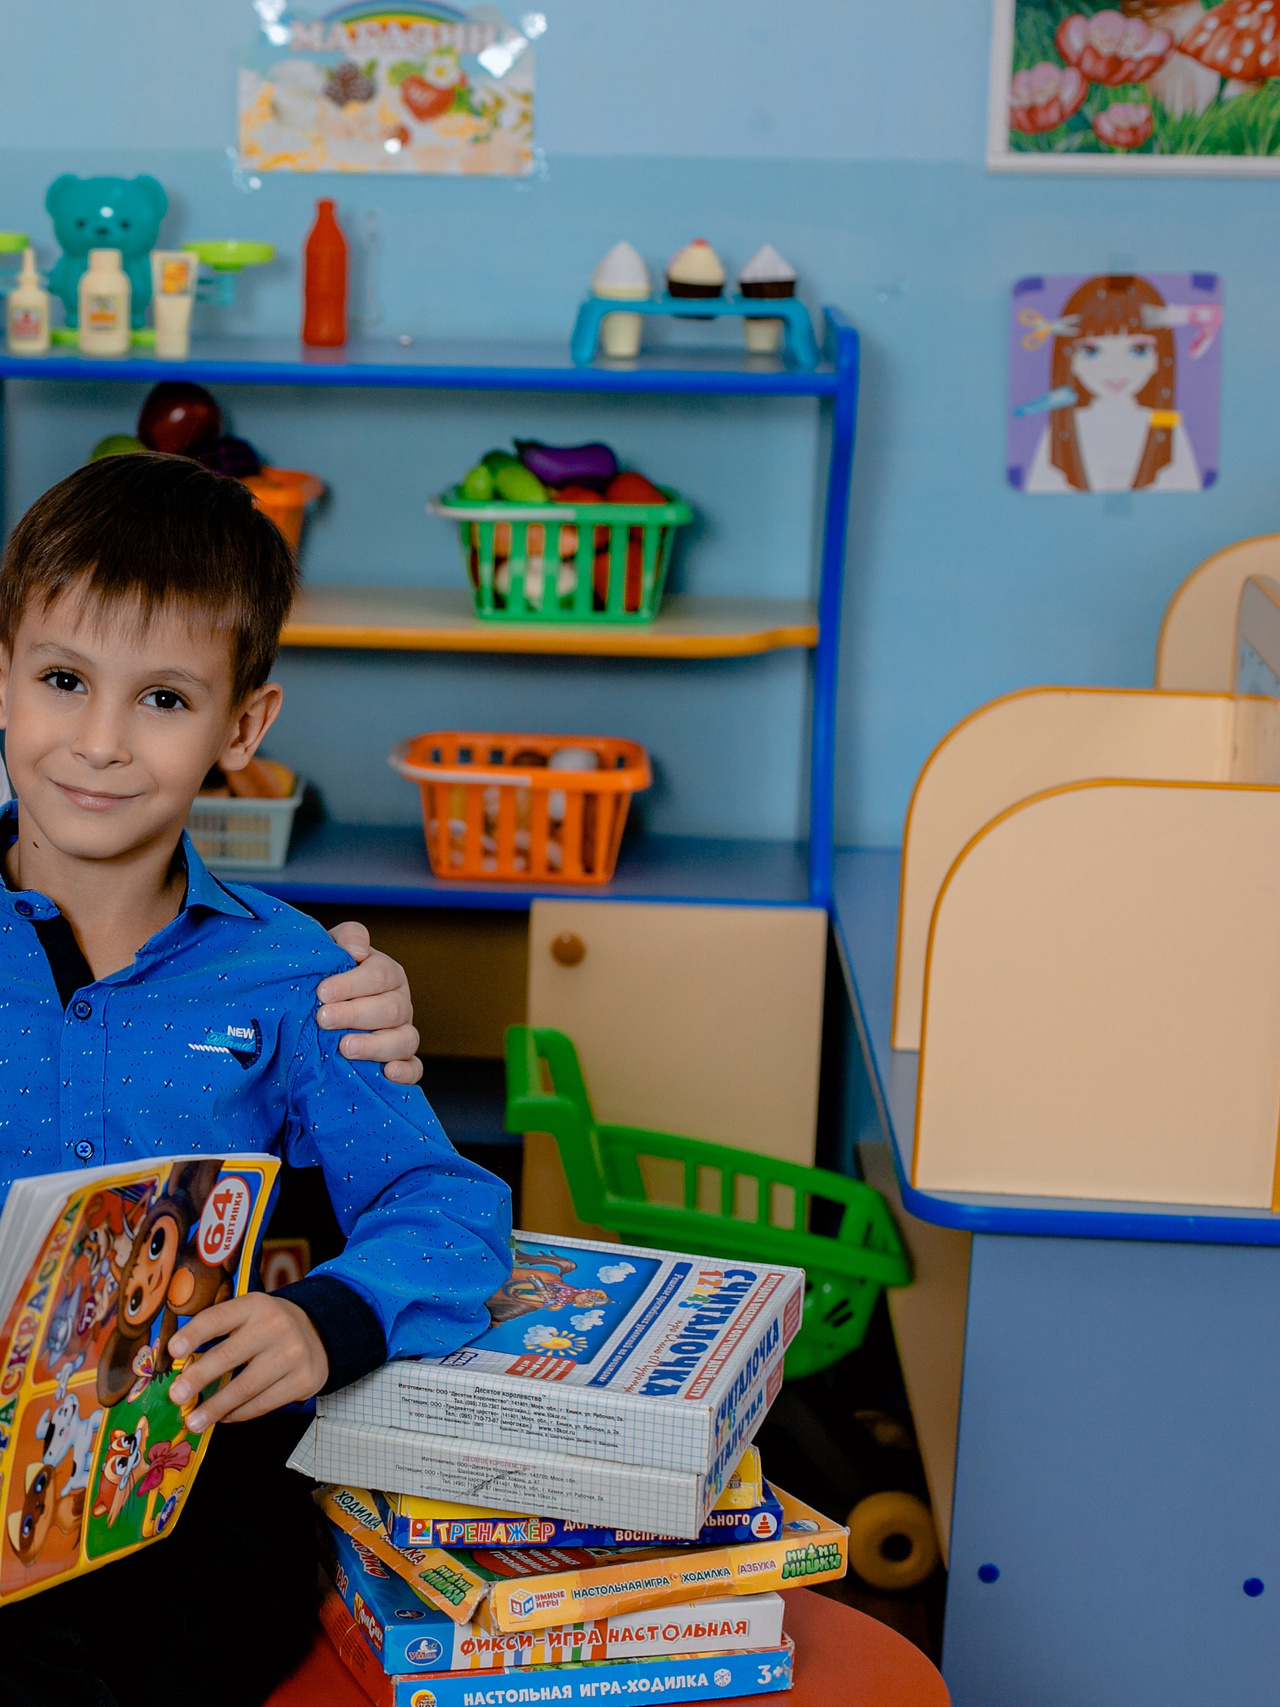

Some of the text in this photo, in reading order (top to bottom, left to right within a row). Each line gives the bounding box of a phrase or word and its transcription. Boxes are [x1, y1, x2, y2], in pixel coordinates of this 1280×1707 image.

[227, 1024, 255, 1040] NEW
[204, 1188, 234, 1255] 64
[223, 1192, 243, 1250] картинки
[639, 1269, 757, 1397] СЧИТАЛОЧКА
[475, 1386, 501, 1396] Десятое
[462, 1455, 489, 1465] ДЕСЯТОЕ
[333, 1490, 383, 1531] ХОДИЛКА
[434, 1517, 556, 1544] ТРЕНАЖЁР
[573, 1560, 777, 1599] НАСТОЛЬНАЯ ИГРА ХОДИЛКА АЗБУКА
[782, 1554, 842, 1580] МИШКИ
[419, 1568, 467, 1606] МИШКИ
[534, 1590, 565, 1601] УМНЫЕ
[535, 1600, 560, 1609] ИГРЫ
[460, 1620, 748, 1655] ФИКСИ-ИГРА НАСТОЛЬНАЯ
[463, 1665, 784, 1706] НАСТОЛЬНАЯ ИГРА-ХОДИЛКА 3+
